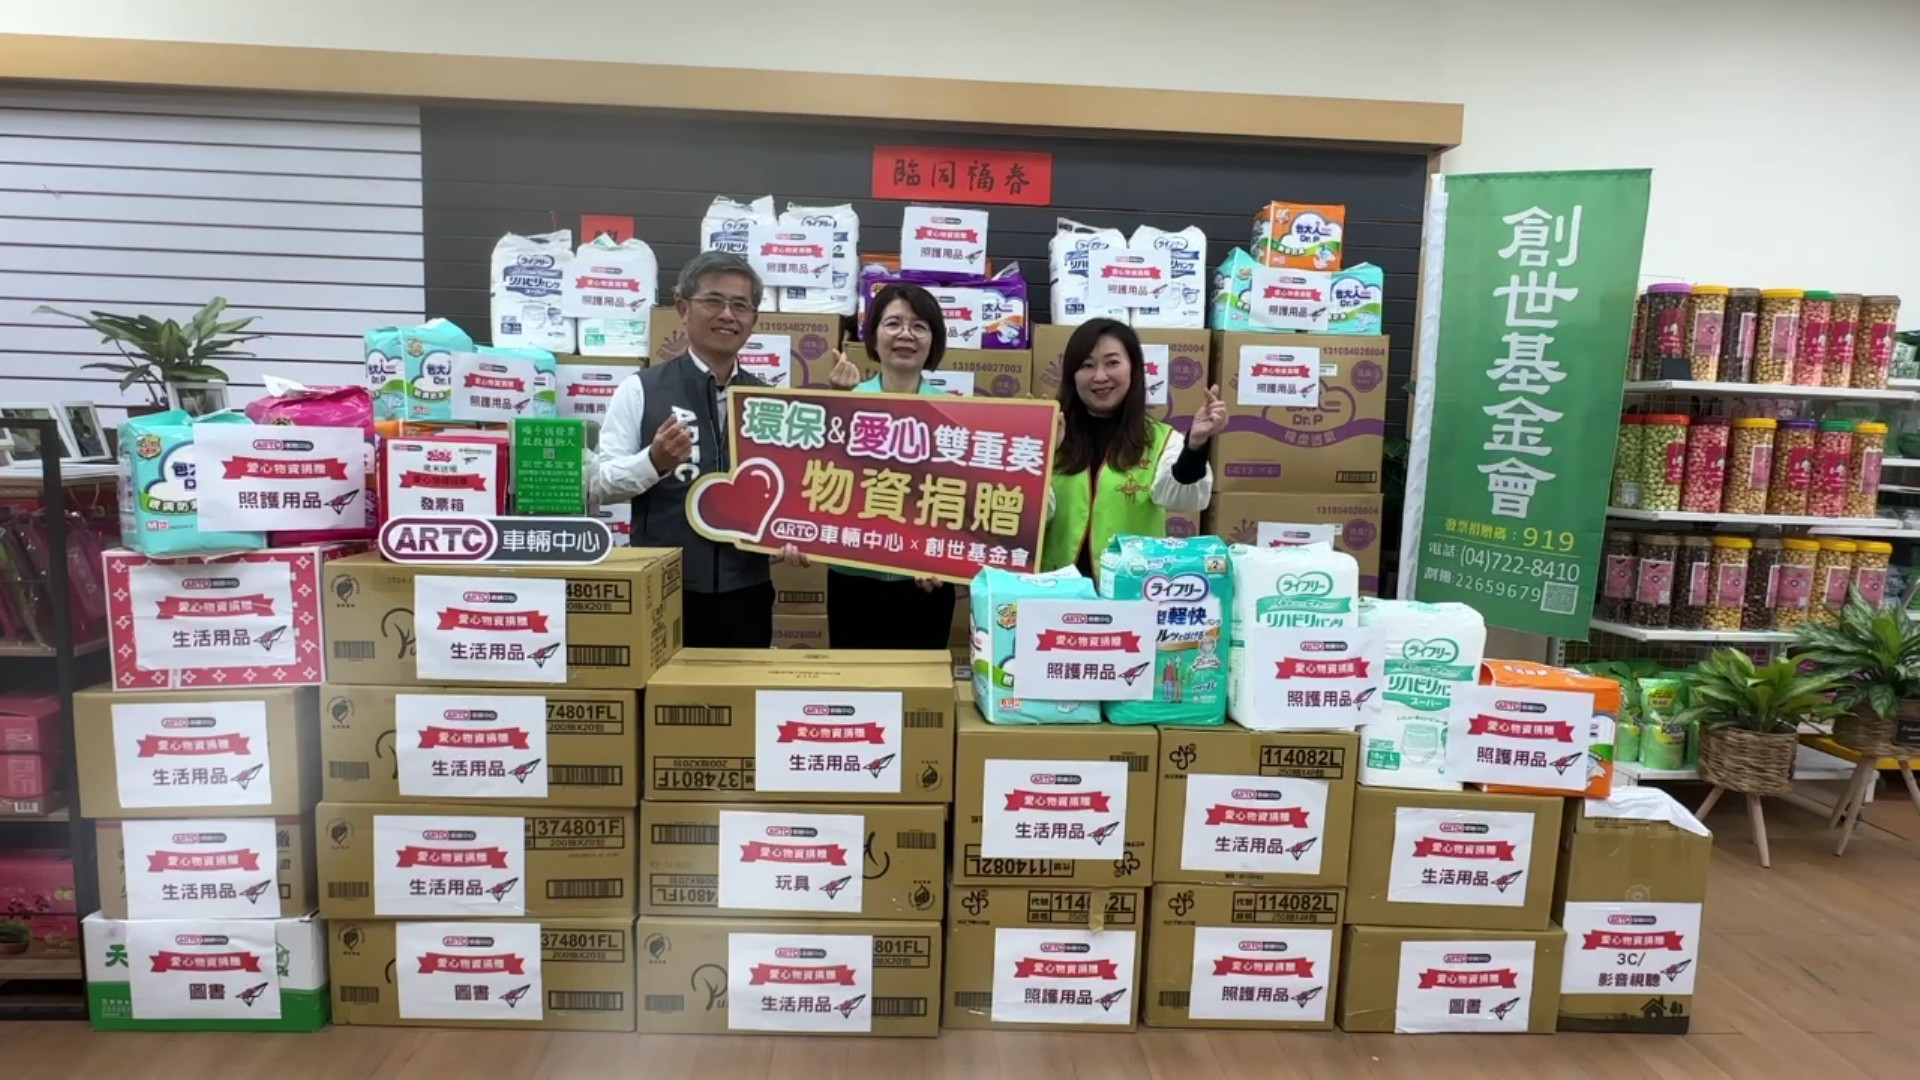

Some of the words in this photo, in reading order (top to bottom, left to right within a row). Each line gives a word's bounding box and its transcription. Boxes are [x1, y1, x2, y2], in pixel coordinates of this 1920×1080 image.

[1477, 204, 1582, 519] 創世基金會
[246, 462, 326, 475] 愛心物資捐贈
[239, 491, 322, 509] 照護用品
[420, 496, 464, 511] 發票箱
[800, 460, 1025, 538] 物資捐贈
[395, 527, 482, 552] ARTC
[503, 530, 600, 553] 車輛中心
[776, 523, 815, 538] ARTC
[820, 525, 903, 553] 車輛中心
[924, 537, 1031, 568] 創世基金會
[1522, 527, 1575, 552] 919
[1150, 582, 1203, 597] ライフリー
[1283, 580, 1325, 592] ライフリー
[1456, 573, 1541, 602] 22659679
[178, 600, 253, 613] 愛心物資捐贈
[458, 614, 529, 628] 愛心物資捐贈
[172, 629, 250, 648] 生活用品
[1055, 635, 1122, 648] 愛心物資捐贈
[450, 642, 525, 661] 生活用品
[1409, 646, 1451, 658] ライフリー
[1047, 662, 1116, 680] 照護用品
[1287, 691, 1351, 707] 照護用品
[546, 704, 617, 719] 74801FL
[438, 732, 509, 744] 愛心物資捐贈
[797, 726, 866, 739] 愛心物資捐贈
[158, 739, 229, 751] 愛心物資捐贈
[789, 755, 861, 772] 生活用品
[1264, 749, 1340, 766] 114082L
[1477, 746, 1547, 768] 照護用品
[152, 768, 228, 786] 生活用品
[431, 760, 506, 778] 生活用品
[658, 771, 739, 788] 374801F
[538, 820, 620, 835] 374801F
[1015, 822, 1085, 839] 生活用品
[1214, 837, 1283, 854] 生活用品
[417, 851, 487, 863] 愛心物資捐贈
[775, 875, 811, 891] 玩具
[1422, 869, 1489, 886] 生活用品
[162, 883, 237, 900] 生活用品
[409, 880, 484, 896] 生活用品
[1055, 894, 1131, 911] 1142L
[1259, 894, 1334, 911] 114082L
[541, 934, 618, 948] 374801FL
[1617, 952, 1646, 966] 3C/
[1034, 963, 1099, 974] 愛心物資捐贈
[1598, 972, 1661, 987] 影音視聽
[189, 983, 225, 1000] 圖書
[455, 985, 490, 1001] 圖書
[1024, 988, 1093, 1005] 照護用品
[1221, 986, 1289, 1002] 照護用品
[761, 996, 831, 1013] 生活用品
[1449, 999, 1481, 1014] 圖書
